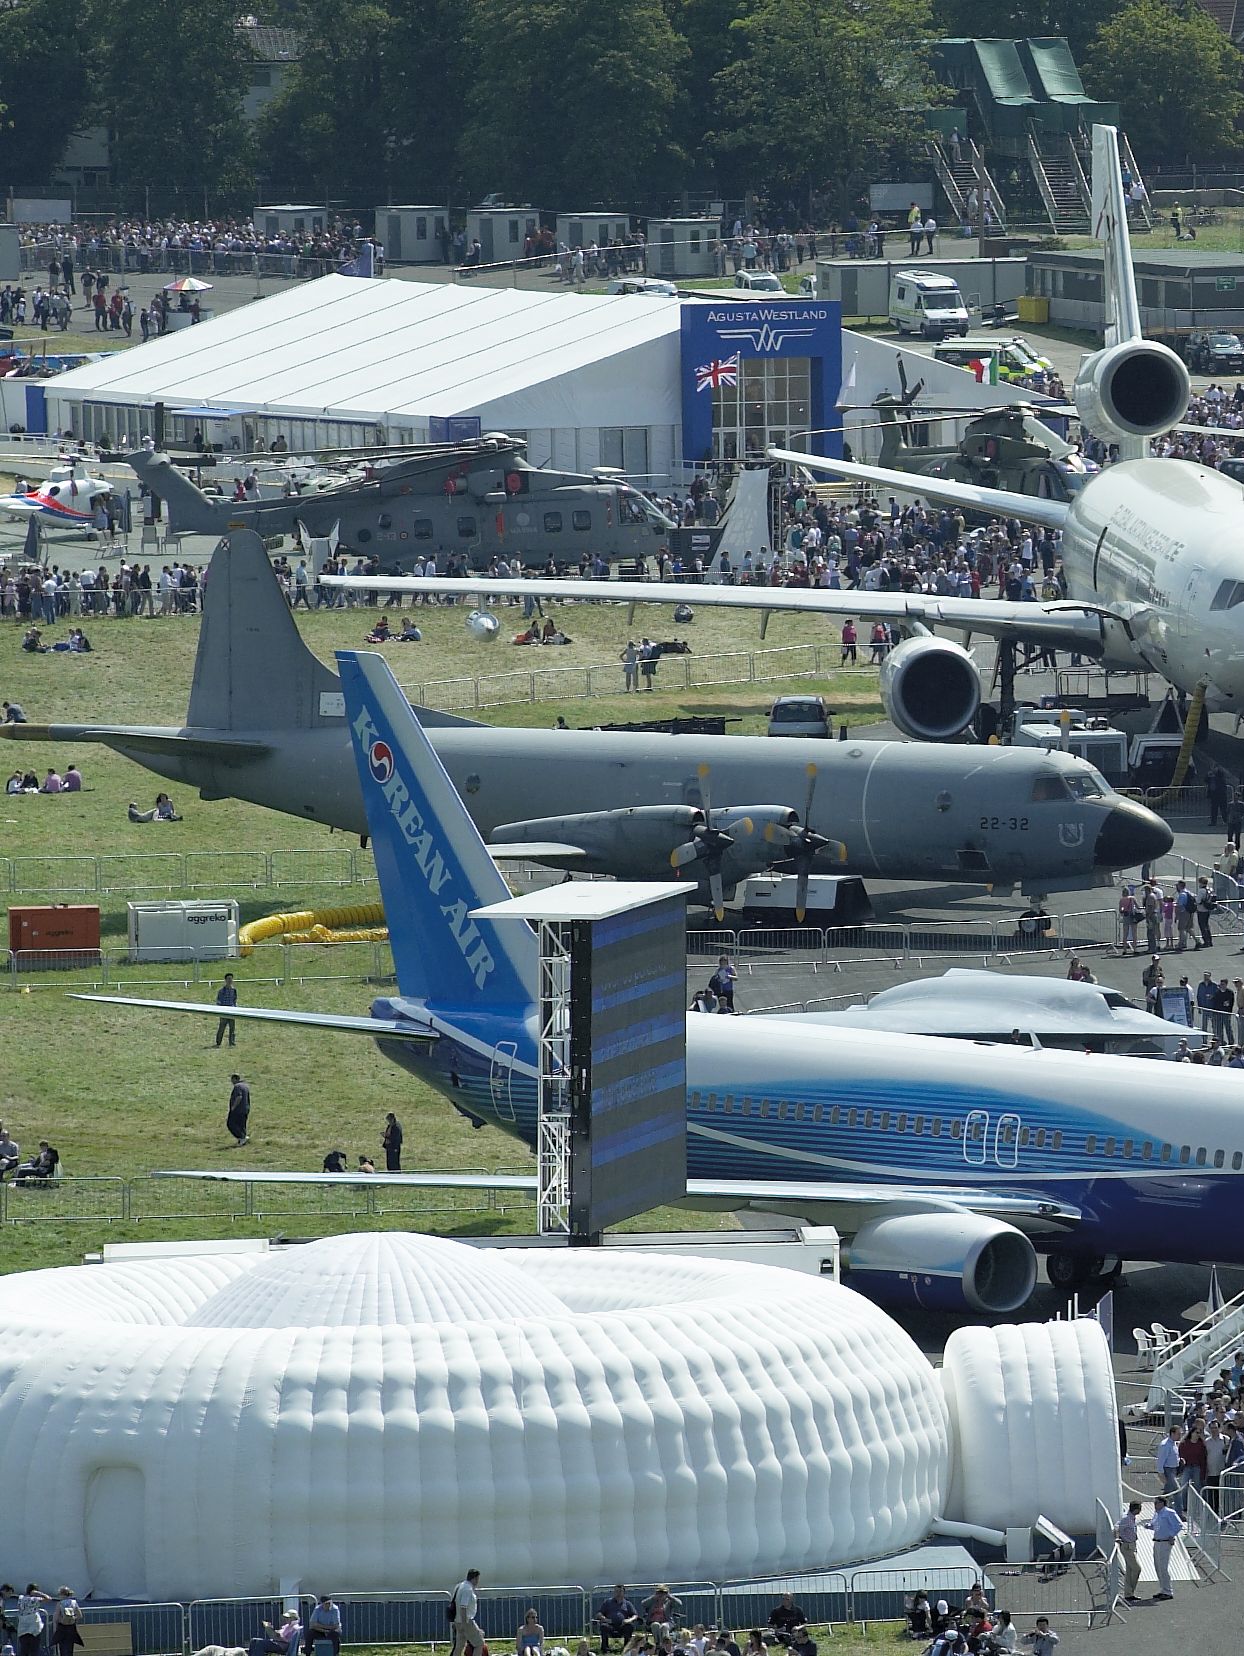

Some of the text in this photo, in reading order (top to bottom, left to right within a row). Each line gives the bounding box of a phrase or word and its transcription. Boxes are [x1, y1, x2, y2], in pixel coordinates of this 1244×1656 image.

[980, 817, 1029, 831] 22-32
[187, 913, 227, 924] aggreko
[440, 897, 495, 991] AIR
